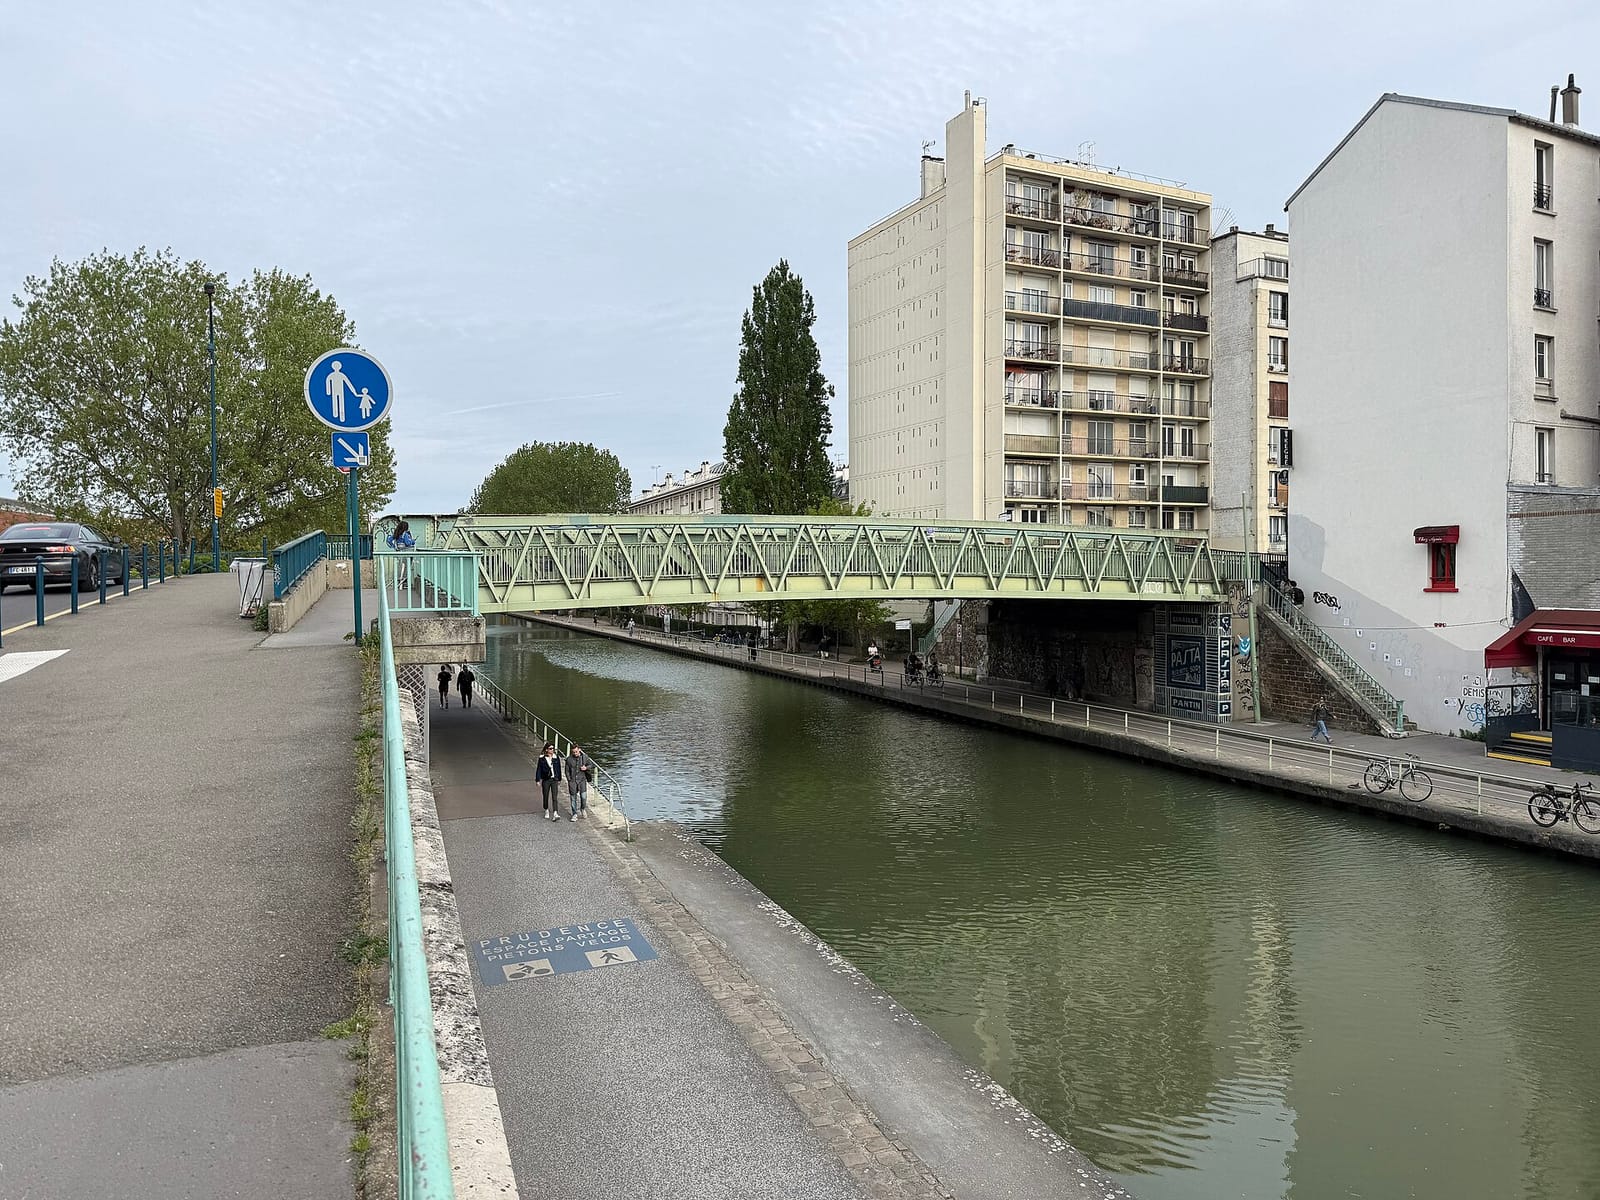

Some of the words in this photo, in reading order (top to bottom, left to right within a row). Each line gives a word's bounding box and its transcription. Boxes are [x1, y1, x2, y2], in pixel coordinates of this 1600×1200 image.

[1537, 635, 1554, 643] CAFÉ
[1171, 647, 1201, 668] PASTA
[1172, 698, 1201, 711] PANTIN
[480, 919, 626, 948] PRUDENCE
[482, 939, 554, 956] ESPACE
[555, 928, 630, 944] PARTAGE
[487, 944, 565, 962] PIETONS
[576, 935, 632, 948] VELOS
